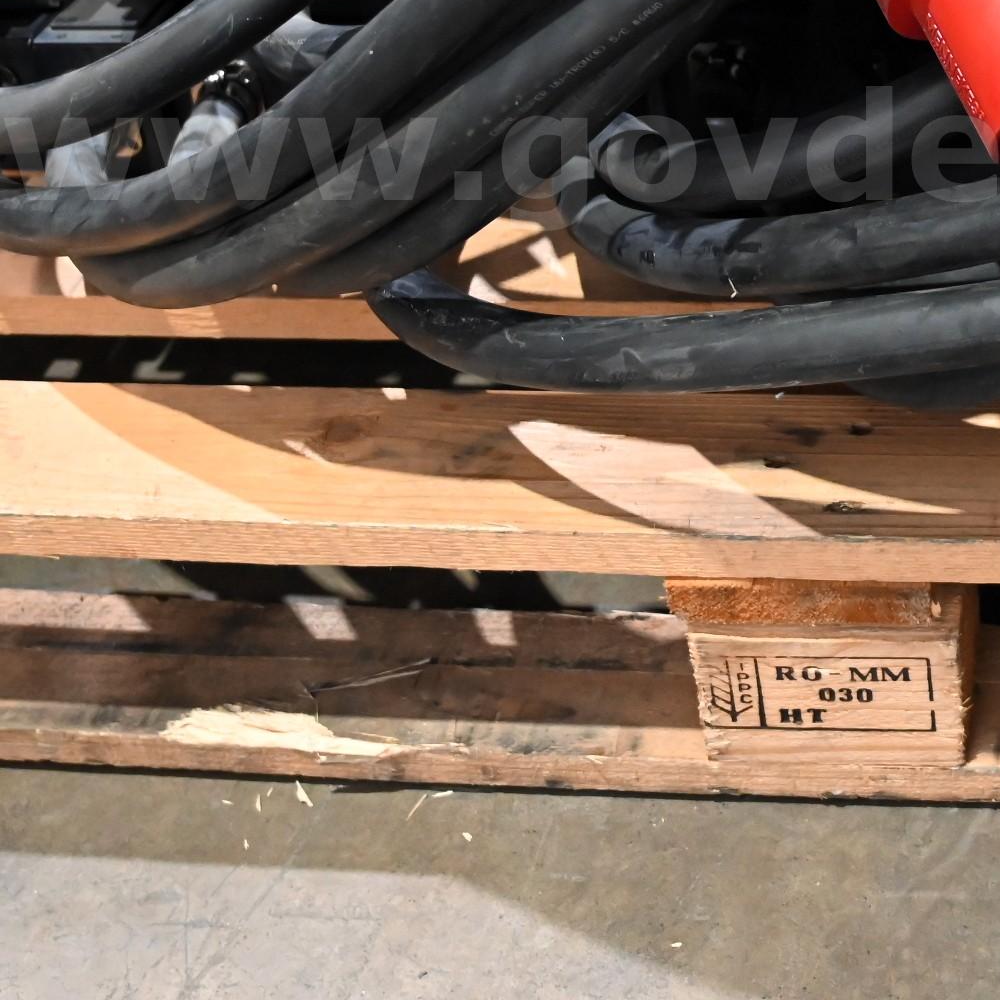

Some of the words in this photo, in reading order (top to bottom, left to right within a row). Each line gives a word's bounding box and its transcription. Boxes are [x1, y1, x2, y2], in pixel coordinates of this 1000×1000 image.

[737, 663, 753, 704] IPPC
[818, 688, 873, 702] 030
[779, 708, 827, 724] HT
